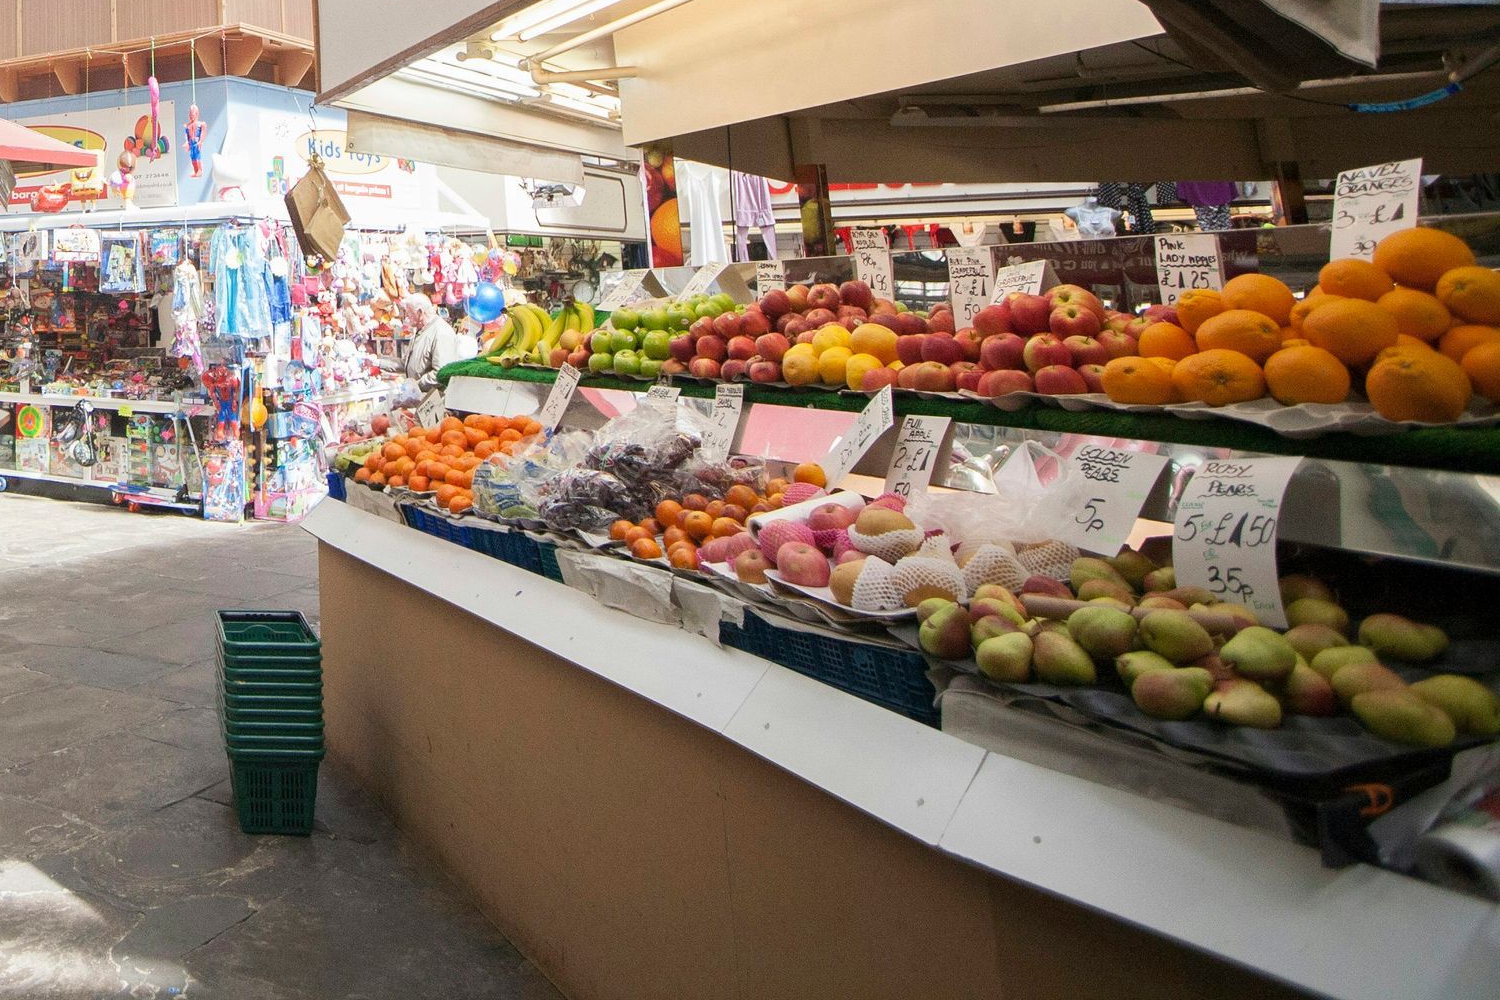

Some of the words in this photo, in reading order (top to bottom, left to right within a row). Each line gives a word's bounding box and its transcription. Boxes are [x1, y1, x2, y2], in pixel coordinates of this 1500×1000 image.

[307, 137, 341, 159] Kids
[349, 150, 381, 167] oys
[1340, 161, 1406, 183] NAVEL
[1337, 177, 1413, 197] ORANGES
[1335, 210, 1356, 230] 3
[1369, 202, 1404, 225] £1
[1159, 252, 1186, 263] LADY
[1188, 255, 1216, 265] APPLES
[954, 280, 962, 295] 2
[969, 278, 987, 297] £1
[893, 446, 907, 469] 2
[906, 447, 931, 472] £1
[1080, 444, 1133, 464] GOLDEN
[1081, 462, 1120, 480] PEARS
[1203, 462, 1253, 476] ROSY
[1207, 479, 1255, 494] PEARS
[1177, 513, 1205, 542] 5
[1204, 511, 1276, 548] £1.50
[1207, 565, 1254, 604] 35p
